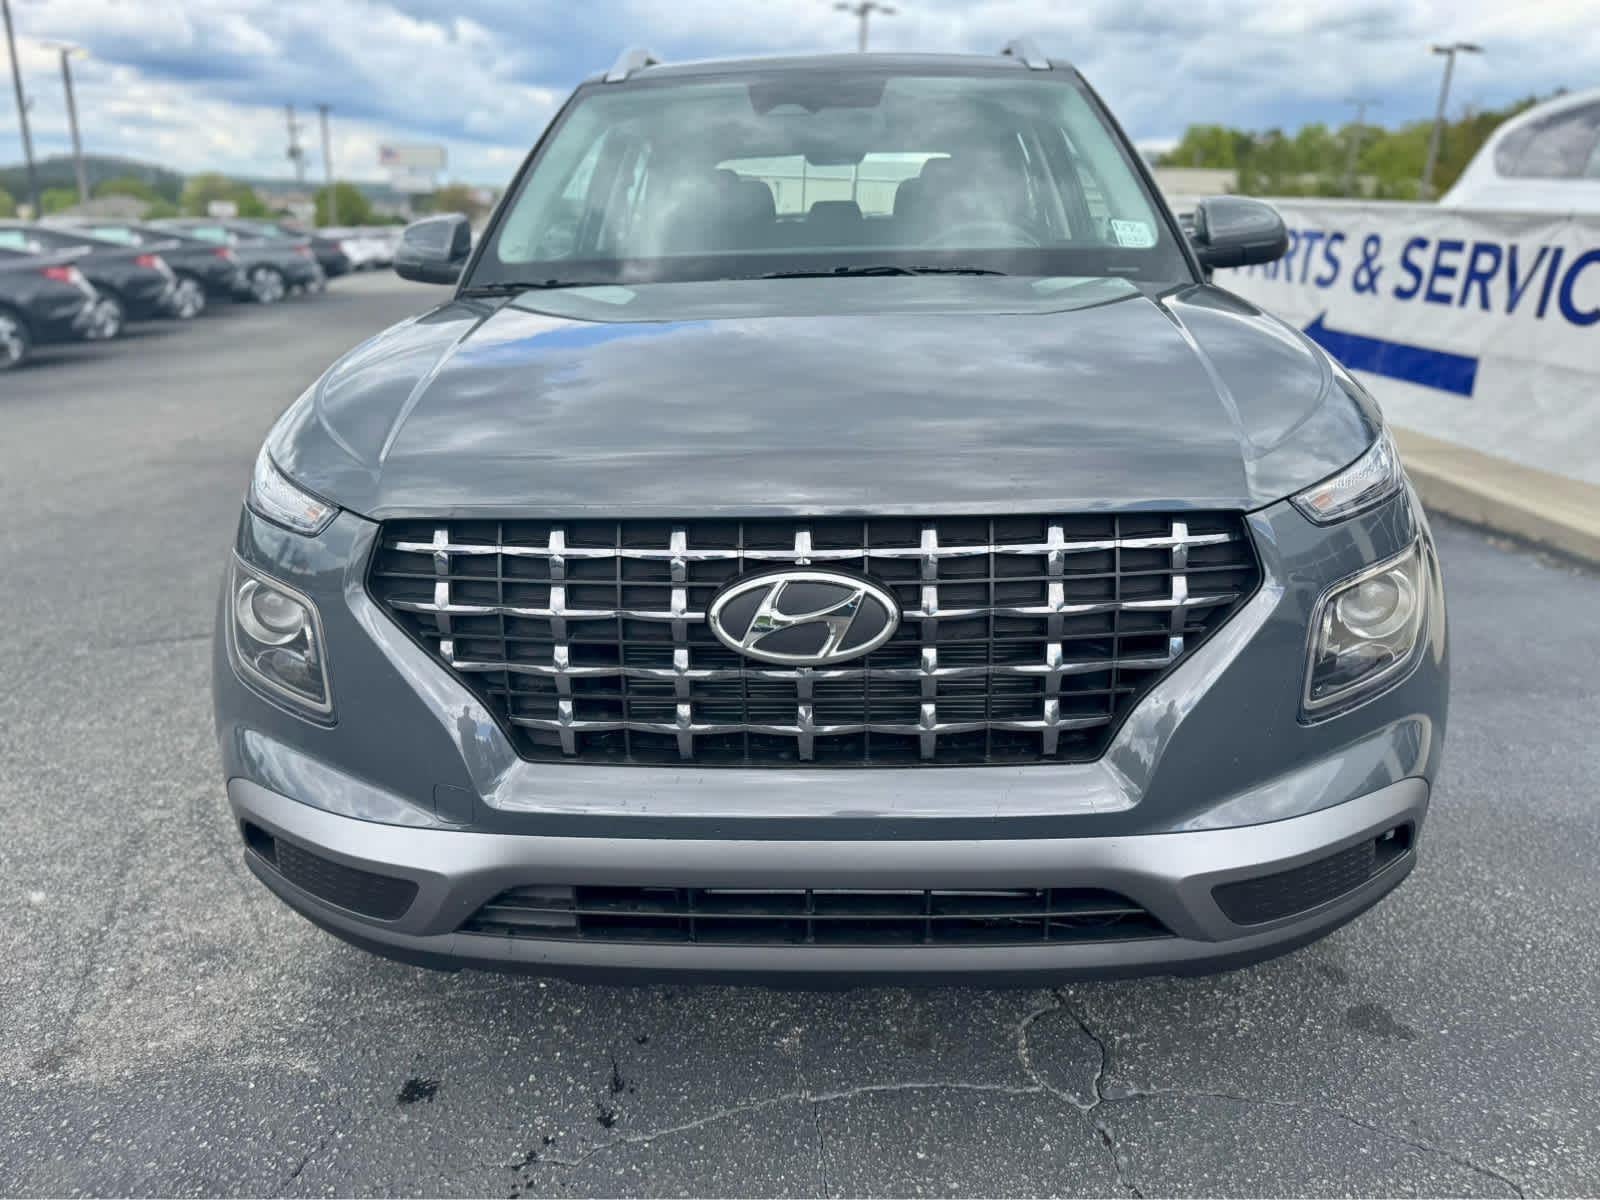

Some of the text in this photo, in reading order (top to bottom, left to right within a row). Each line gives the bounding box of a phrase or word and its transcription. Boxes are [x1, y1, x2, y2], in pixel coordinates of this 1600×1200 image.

[1233, 228, 1600, 326] RTS & SERVIC
